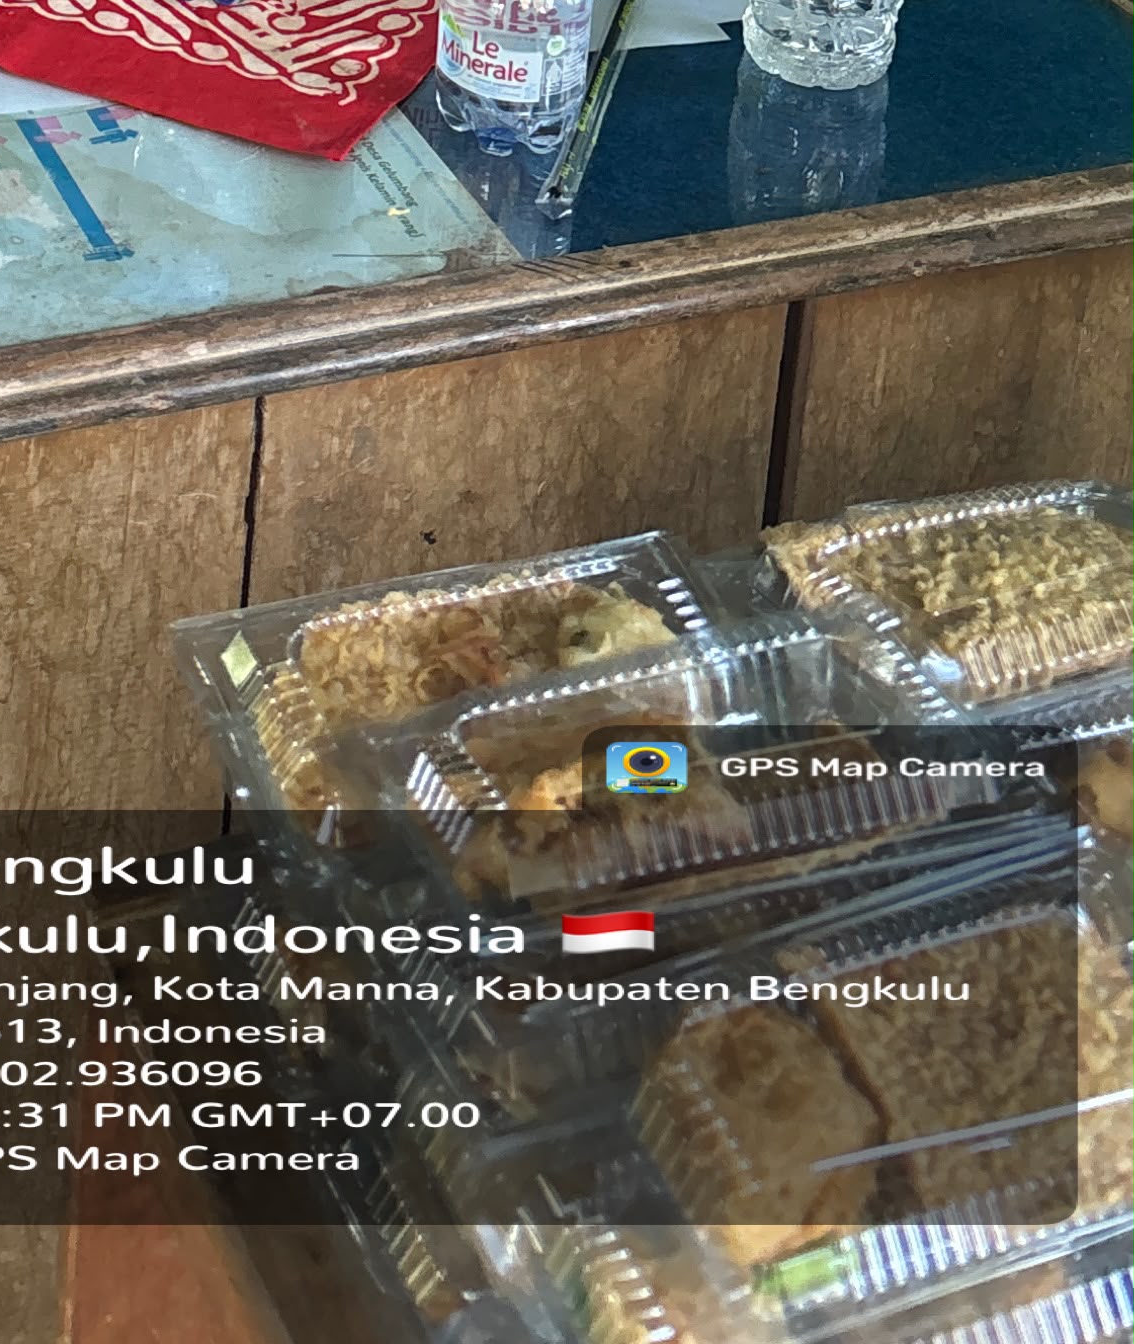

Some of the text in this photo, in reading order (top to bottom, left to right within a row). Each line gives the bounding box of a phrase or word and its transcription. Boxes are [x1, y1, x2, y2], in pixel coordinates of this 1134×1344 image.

[442, 30, 528, 83] Minerale
[473, 31, 499, 59] Le
[378, 160, 418, 207] Gelumbang
